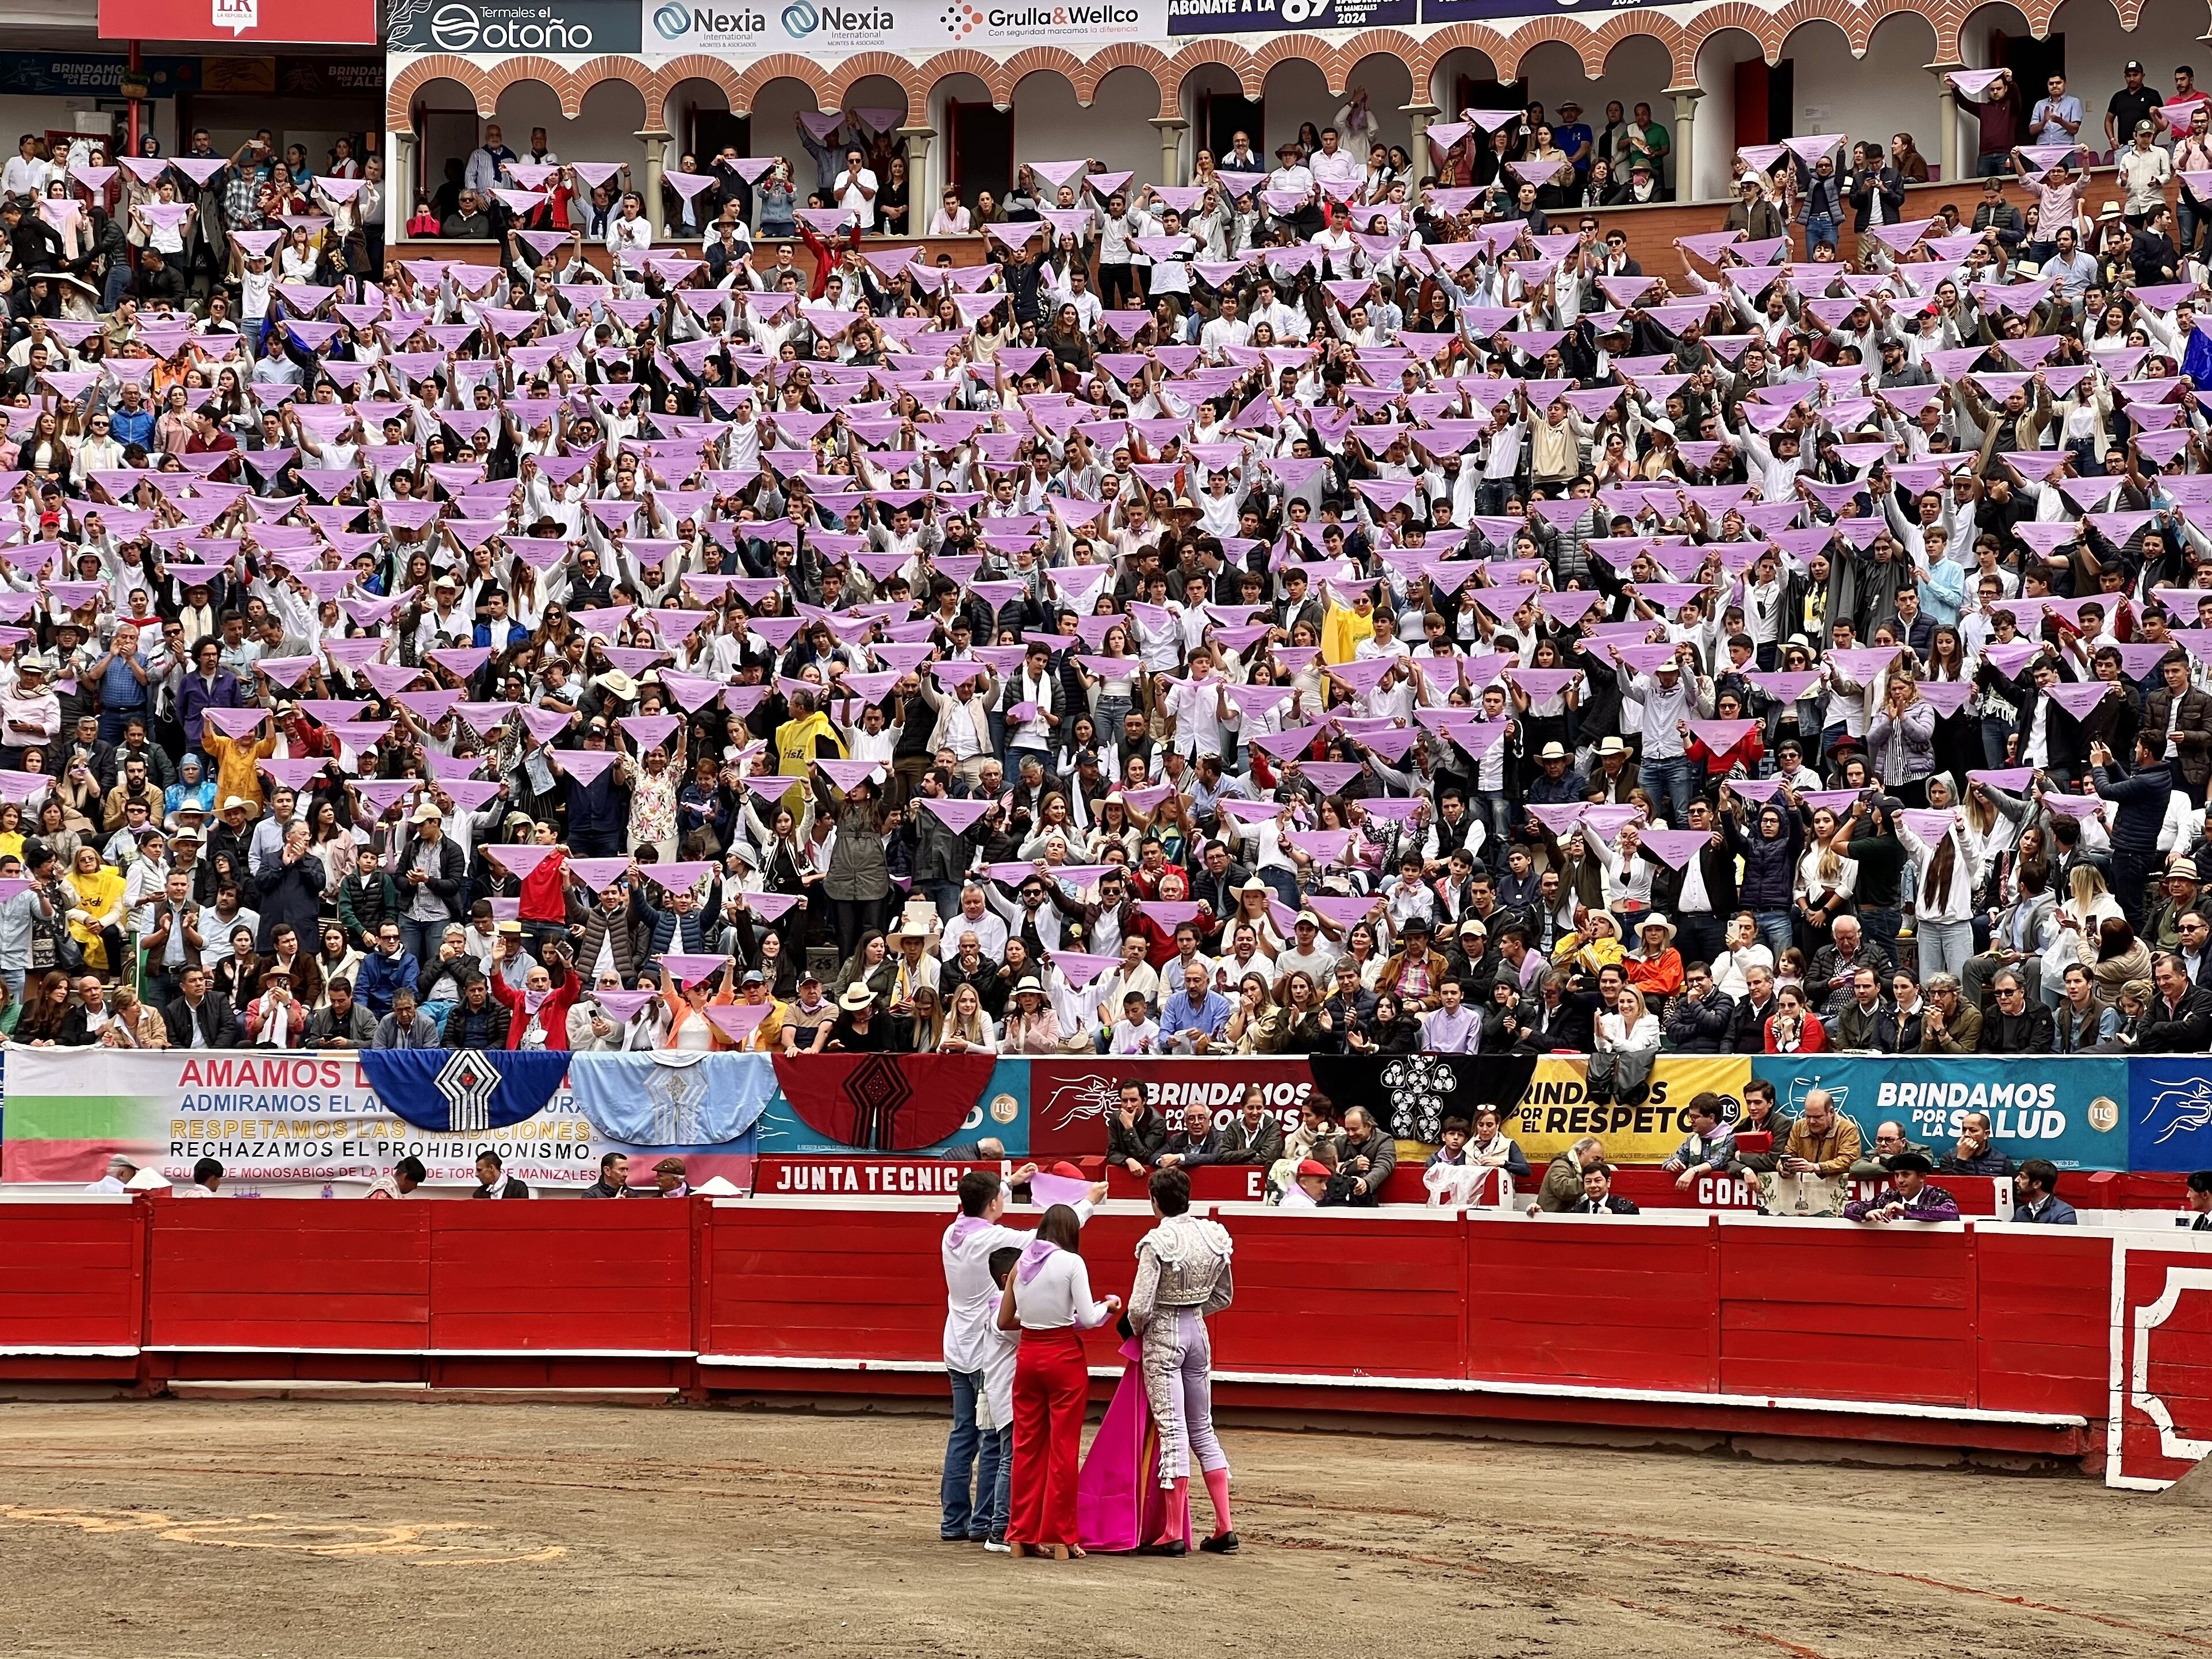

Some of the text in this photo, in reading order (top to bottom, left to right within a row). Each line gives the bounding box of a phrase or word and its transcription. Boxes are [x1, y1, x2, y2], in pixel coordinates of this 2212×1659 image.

[479, 6, 551, 18] Termales el
[1241, 0, 1252, 12] A
[1344, 4, 1377, 12] MANIZALES
[694, 8, 765, 32] Nexia
[822, 6, 893, 30] Nexia
[1337, 13, 1366, 24] 2024
[482, 18, 593, 48] otoño
[704, 32, 753, 40] International
[832, 30, 881, 39] International
[1007, 28, 1045, 37] seguridad
[52, 63, 125, 74] BRINDAMO
[178, 1059, 341, 1088] AMAMOS
[1877, 1082, 2056, 1108] BRINDAMOS
[181, 1095, 321, 1112] ADMIRAMOS
[329, 1095, 356, 1112] EL
[1165, 1109, 1184, 1119] PO
[1510, 1107, 1542, 1120] POR
[1912, 1109, 1946, 1123] POR
[170, 1119, 348, 1140] RESPETAMOS
[356, 1120, 406, 1139] LAS
[1522, 1120, 1540, 1133] EL
[1922, 1123, 1944, 1137] LA
[170, 1141, 597, 1160] RECHAZAMOS EL PROHIBICIONISMO.
[164, 1167, 193, 1178] EQU
[241, 1167, 334, 1178] MONOSABIOS
[339, 1167, 356, 1177] DE
[361, 1167, 378, 1177] LA
[427, 1168, 443, 1178] DE
[448, 1168, 478, 1179] TOR
[519, 1169, 597, 1180] MANIZALES
[777, 1166, 973, 1191] JUNTA TECNIC
[1503, 1180, 1508, 1195] 8
[2002, 1189, 2007, 1204] 9
